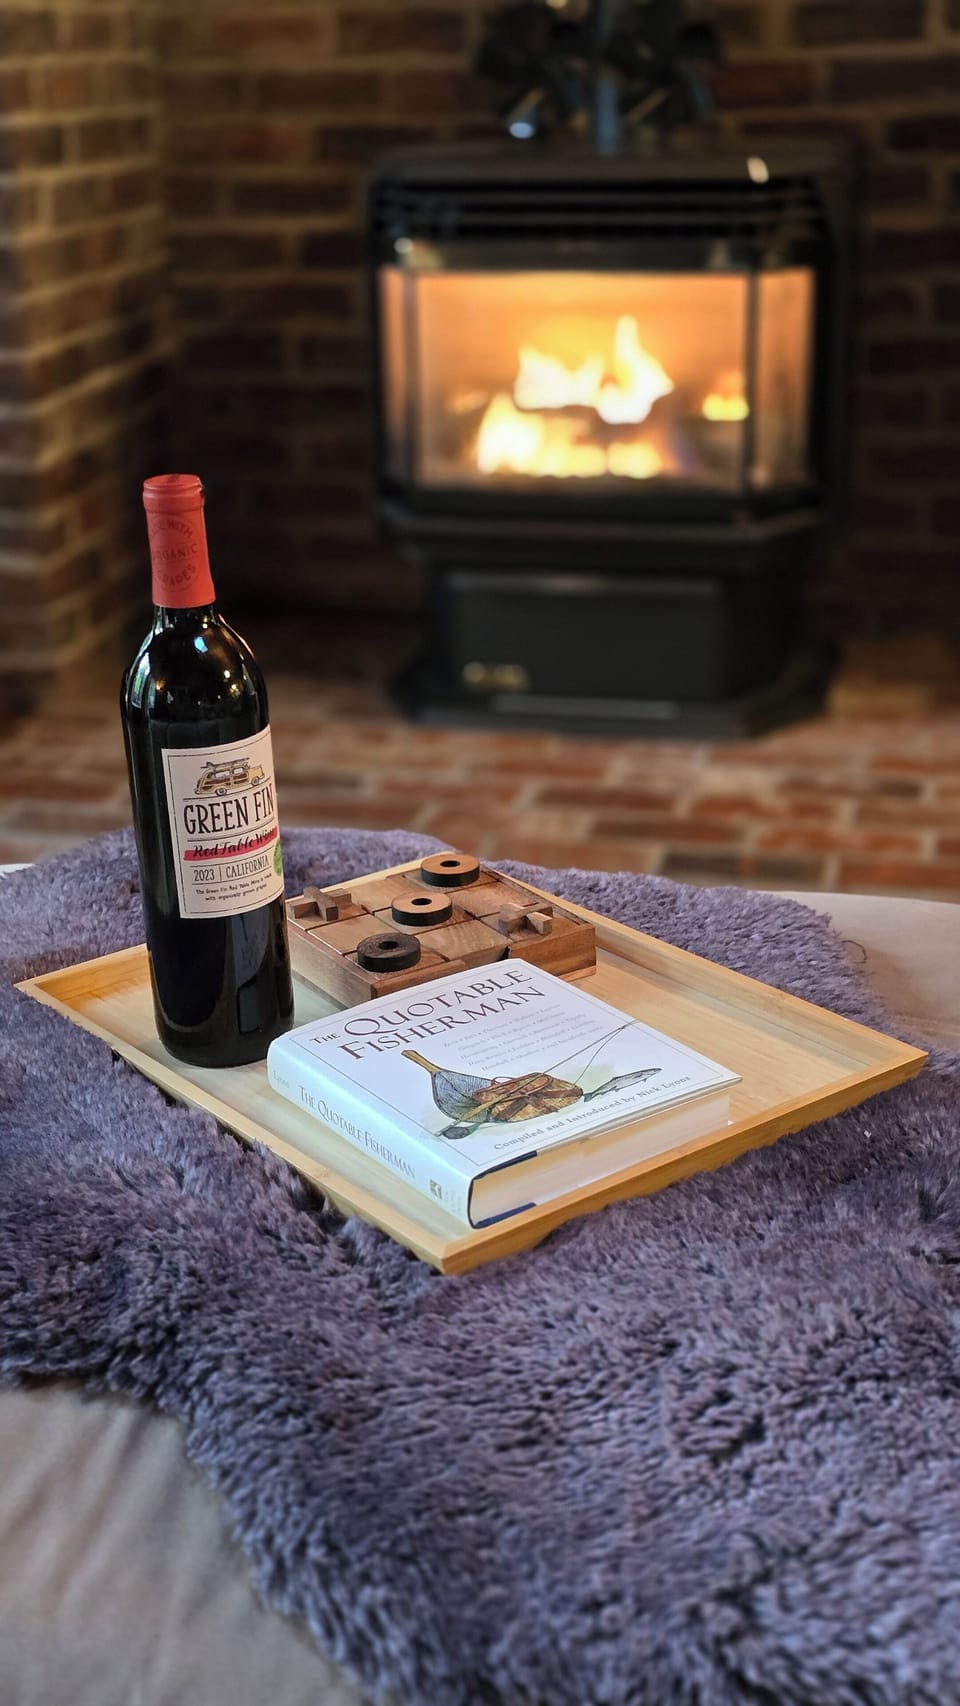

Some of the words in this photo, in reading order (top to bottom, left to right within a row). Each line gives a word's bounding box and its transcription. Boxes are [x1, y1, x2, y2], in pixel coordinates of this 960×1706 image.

[183, 796, 249, 835] GREEN
[253, 783, 274, 822] FIN
[193, 843, 218, 857] Red
[220, 835, 254, 855] Table
[193, 869, 215, 882] 2023
[225, 855, 270, 879] CALIFORNIA
[312, 1031, 341, 1045] THE
[343, 969, 533, 1036] QUOTABLE
[338, 985, 546, 1060] FISHERMAN
[298, 1084, 316, 1109] THE
[317, 1099, 362, 1142] QUOTABLE
[364, 1130, 416, 1179] FISHERMAN
[494, 1127, 546, 1150] Compiled
[546, 1119, 565, 1132] and
[565, 1098, 622, 1124] Introduced
[622, 1094, 637, 1107] by
[636, 1085, 662, 1099] Nick
[662, 1074, 692, 1090] Lyons
